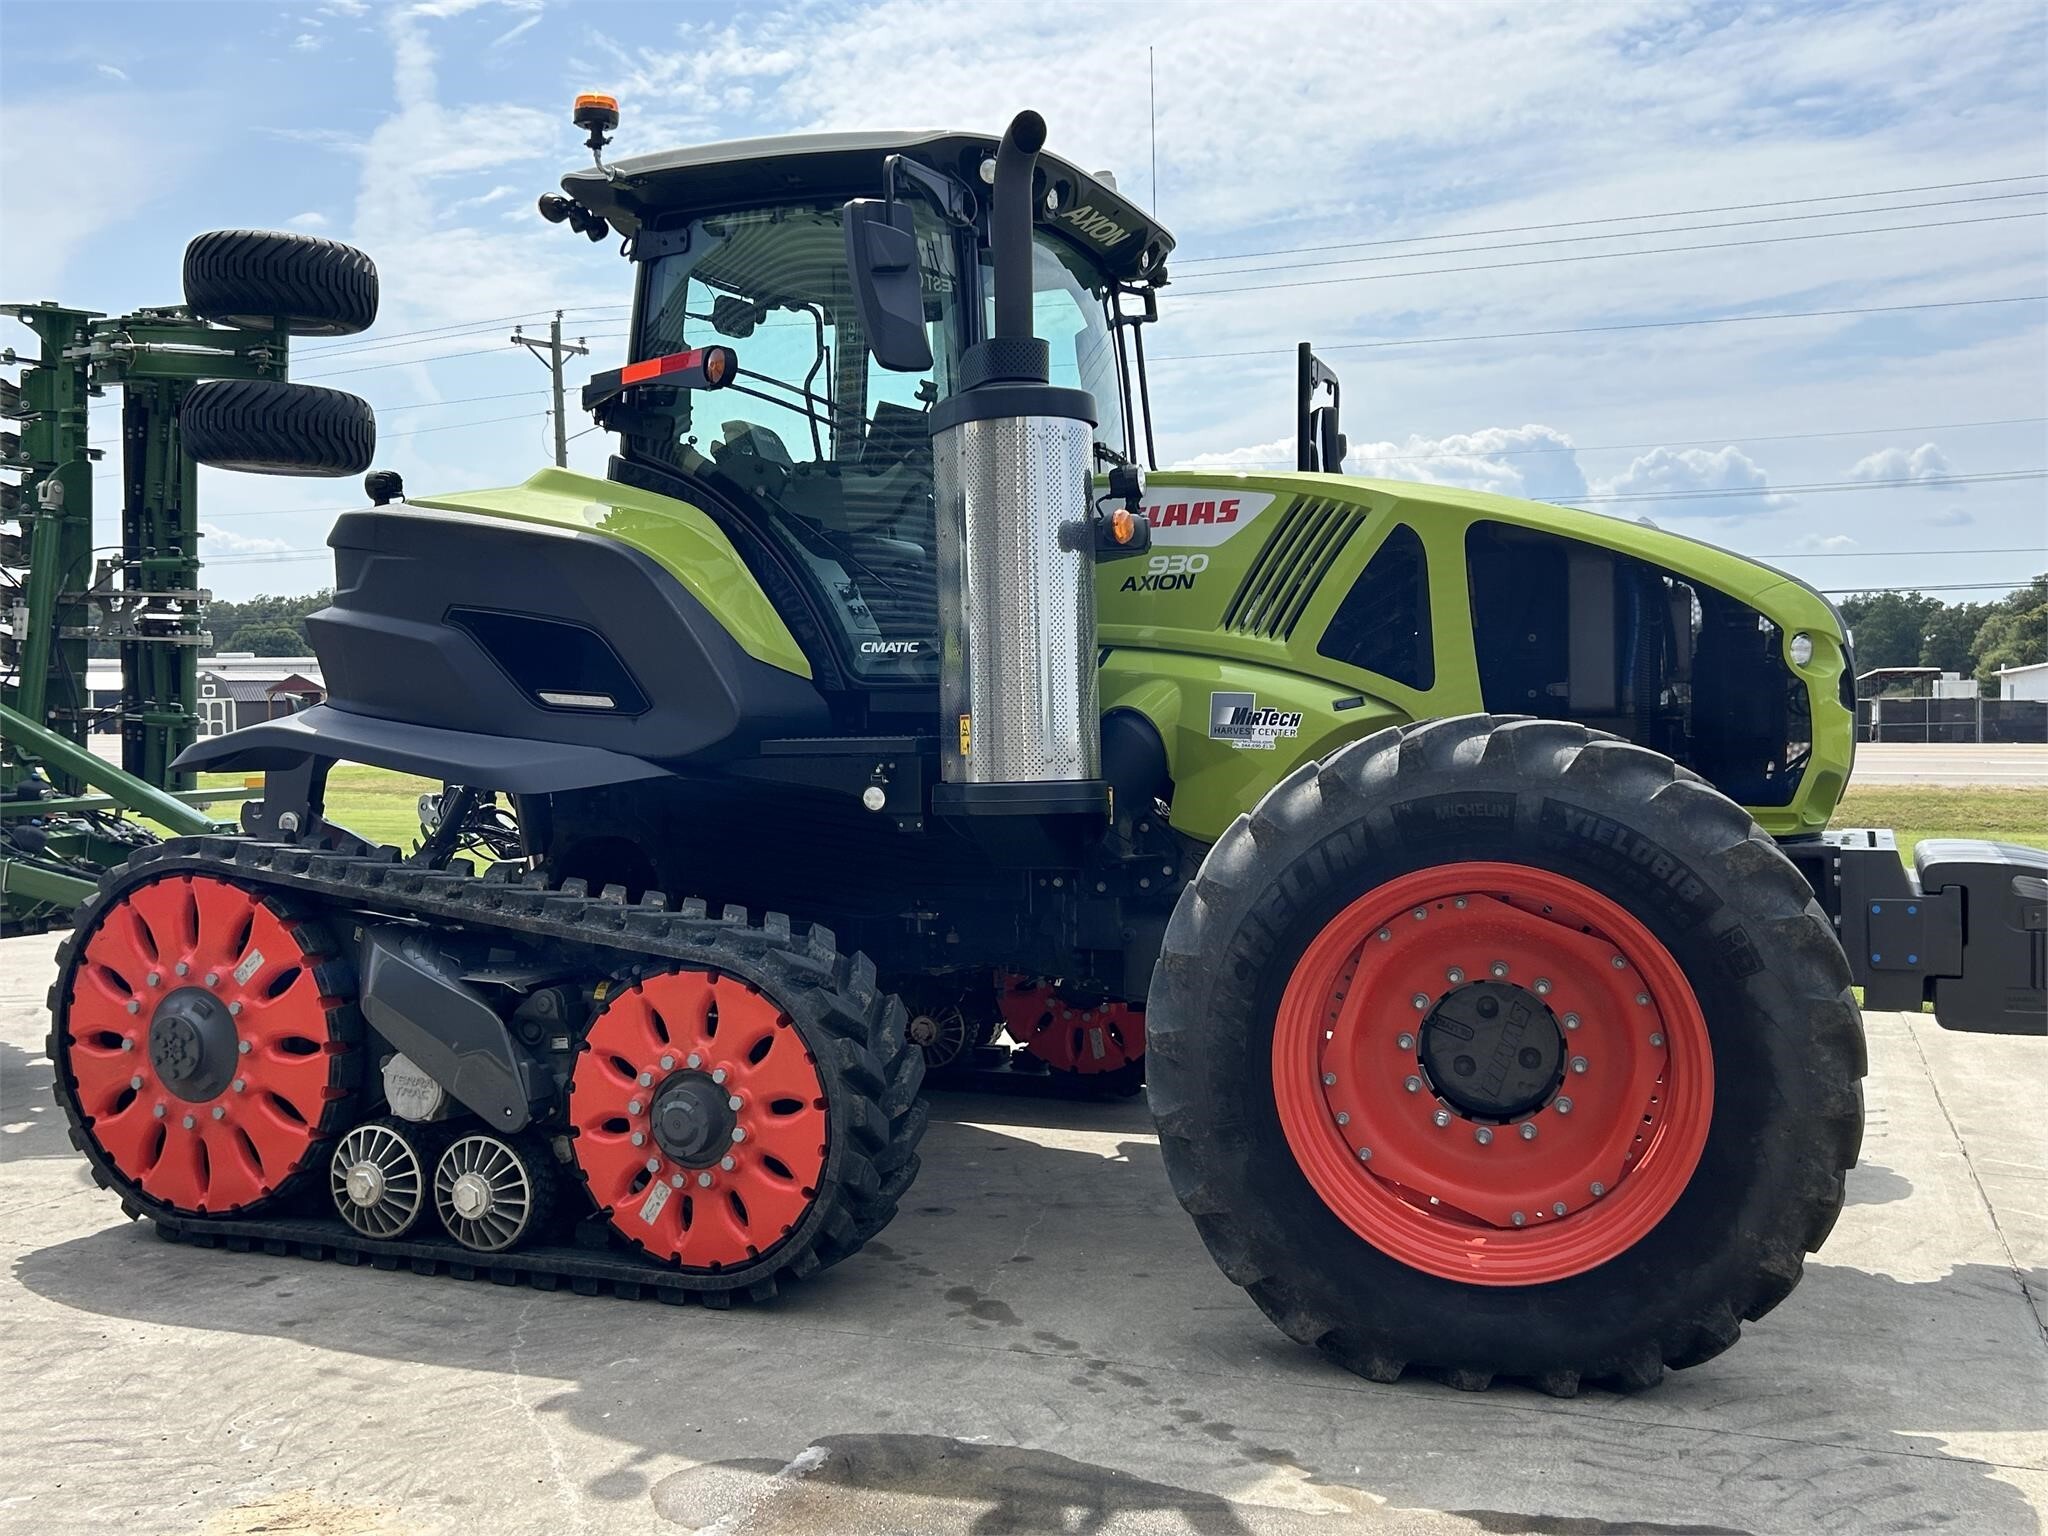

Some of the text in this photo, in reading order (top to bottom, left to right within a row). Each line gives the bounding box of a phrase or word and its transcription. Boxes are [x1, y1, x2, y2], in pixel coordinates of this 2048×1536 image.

[1060, 205, 1131, 247] AXION
[1148, 554, 1209, 575] 930
[1120, 573, 1196, 592] AXION
[860, 641, 919, 653] CMATIC
[1213, 726, 1297, 737] HARVEST CENTER
[1433, 802, 1510, 821] MICHELIN
